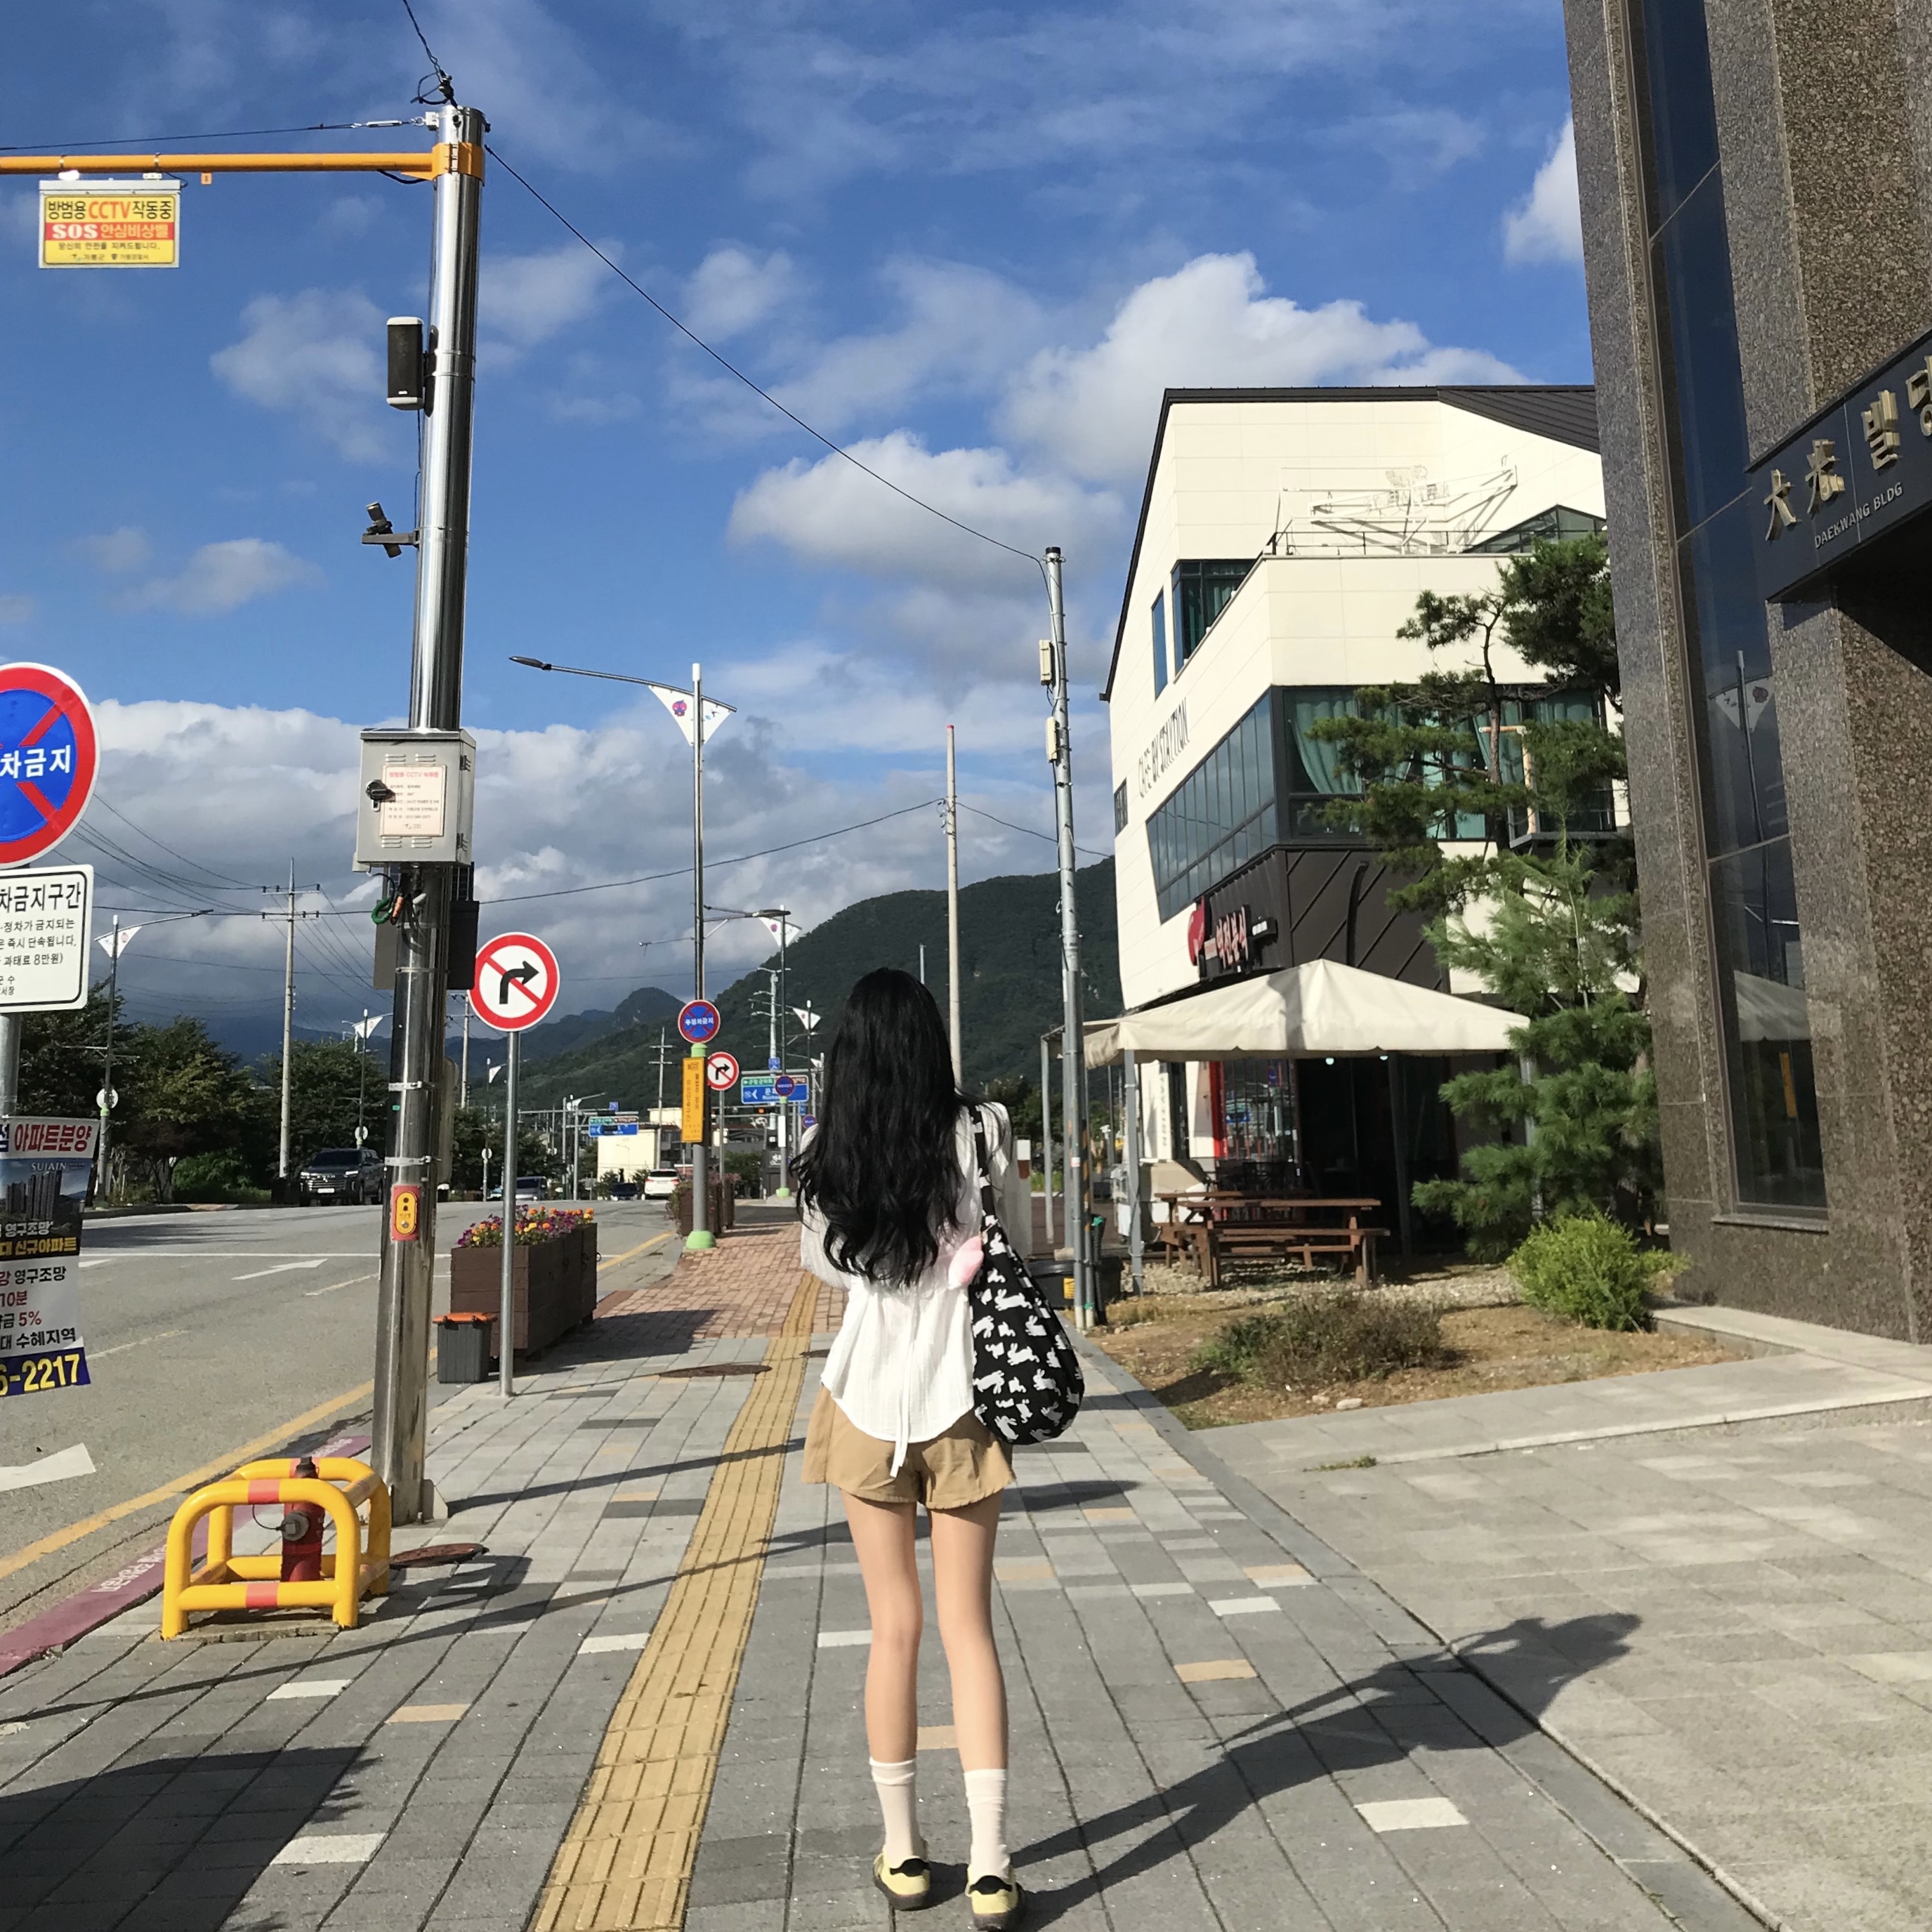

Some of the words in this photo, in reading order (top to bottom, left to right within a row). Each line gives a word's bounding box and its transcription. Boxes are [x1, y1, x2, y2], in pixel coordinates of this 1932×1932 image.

[48, 201, 86, 219] 방범용
[88, 201, 131, 219] CCTV
[132, 201, 171, 219] 작동중
[52, 224, 98, 239] SOS
[100, 224, 169, 239] 안심비상벨
[1814, 508, 1869, 548] DAEKWANG
[1874, 482, 1903, 511] BLDG
[36, 918, 75, 931] 금지되는
[8, 938, 25, 949] 즉시
[28, 934, 77, 948] 단속됩니다.
[4, 955, 31, 966] 과태료
[34, 952, 63, 966] 8만원)
[15, 1124, 93, 1152] 아파트분양
[32, 1162, 67, 1171] SUJAIN
[5, 1221, 53, 1237] 영구조망
[15, 1237, 77, 1256] 신규아파트
[15, 1266, 66, 1284] 영구조망
[18, 1310, 42, 1327] 5%
[16, 1327, 77, 1349] 수혜지역
